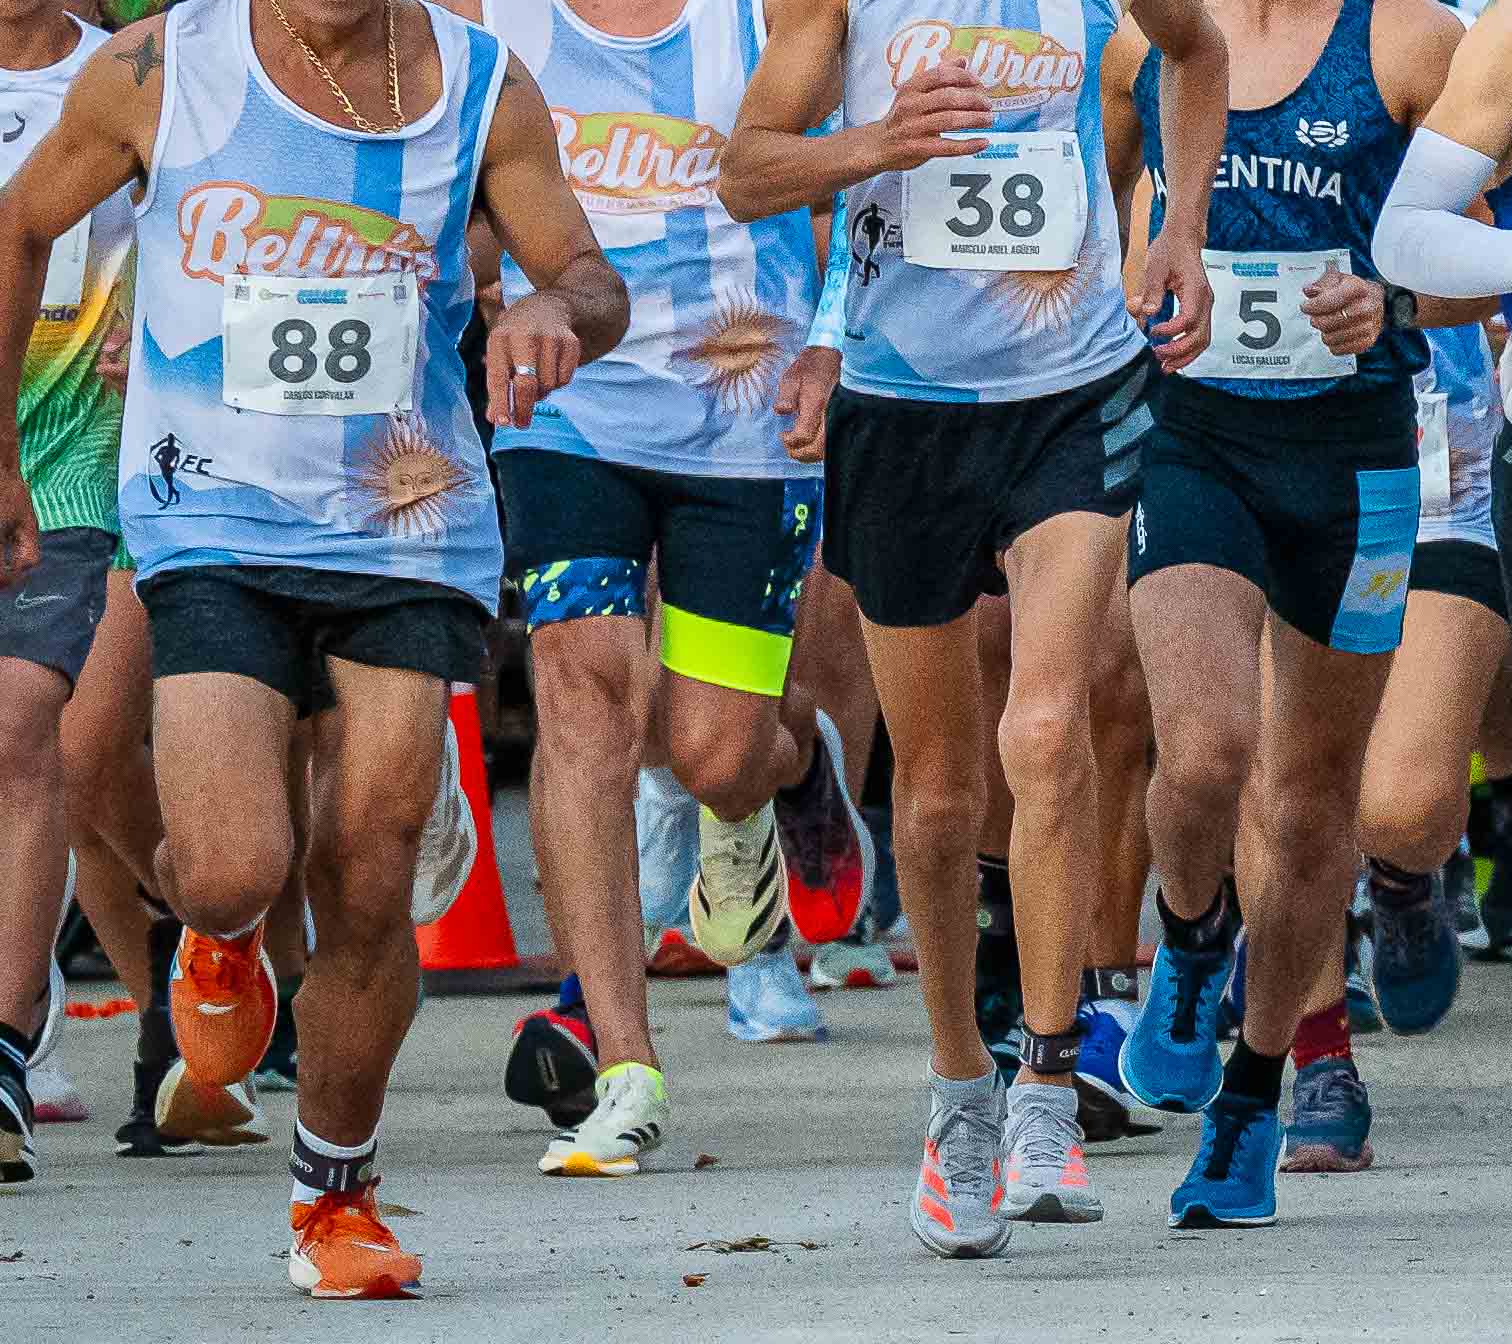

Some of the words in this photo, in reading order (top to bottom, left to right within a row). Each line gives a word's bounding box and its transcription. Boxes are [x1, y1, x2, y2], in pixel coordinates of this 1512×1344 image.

[946, 173, 1046, 238] 38
[268, 318, 372, 384] 88
[1236, 290, 1282, 350] 5
